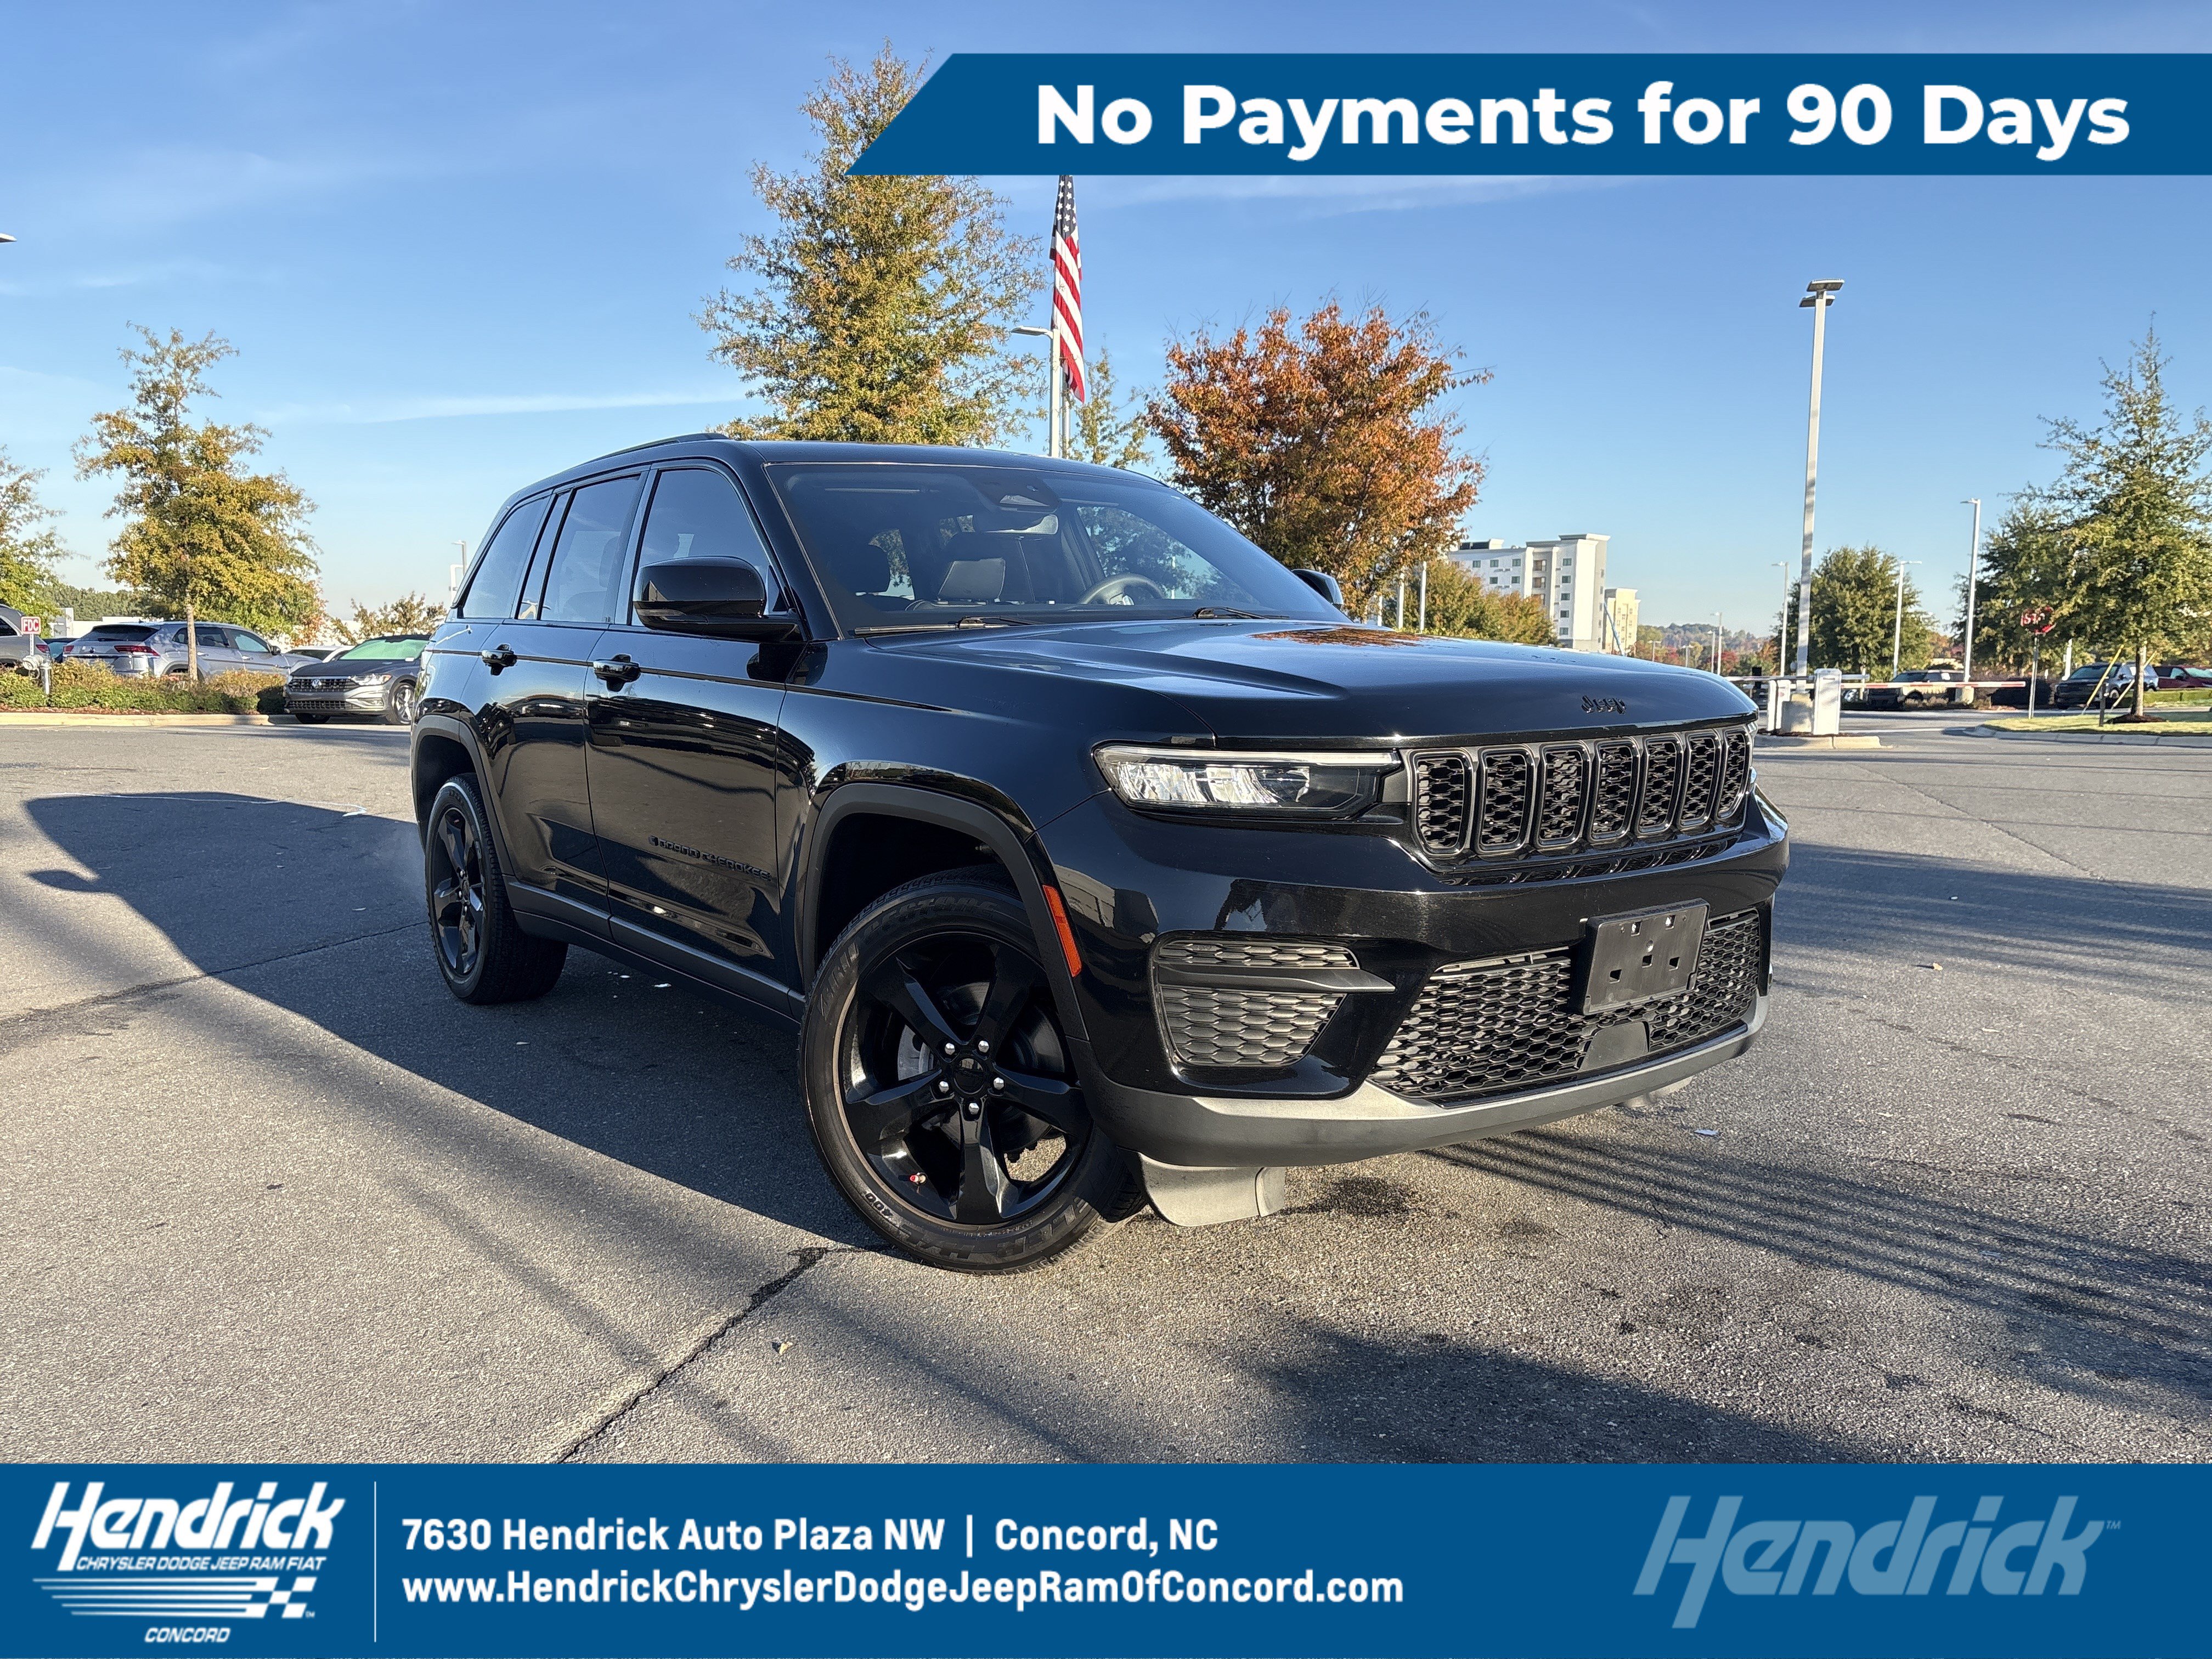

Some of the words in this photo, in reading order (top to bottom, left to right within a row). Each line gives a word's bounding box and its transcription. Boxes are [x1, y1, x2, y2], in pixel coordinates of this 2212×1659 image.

[23, 619, 39, 631] FDC
[1581, 695, 1627, 714] Jeep
[865, 1192, 894, 1217] 400
